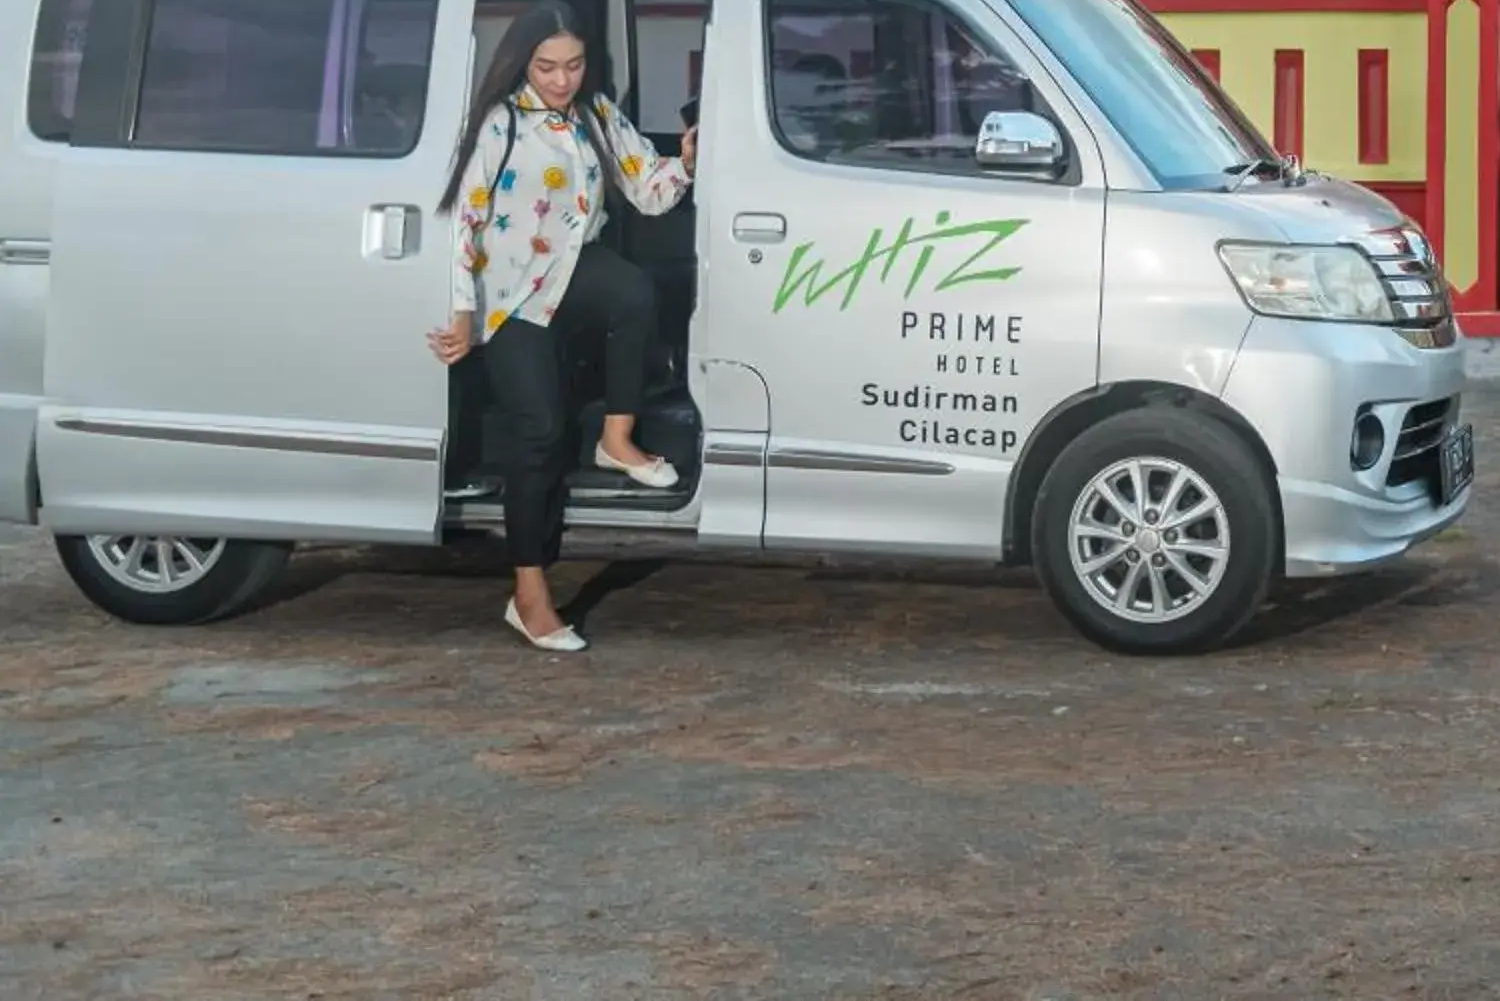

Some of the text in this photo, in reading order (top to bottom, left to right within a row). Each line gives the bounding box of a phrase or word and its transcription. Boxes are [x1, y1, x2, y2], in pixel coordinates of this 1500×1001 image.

[901, 311, 1023, 343] PRIME
[936, 354, 1019, 376] HOTEL
[861, 383, 1018, 413] Sudirman
[899, 420, 1018, 452] Cilacap
